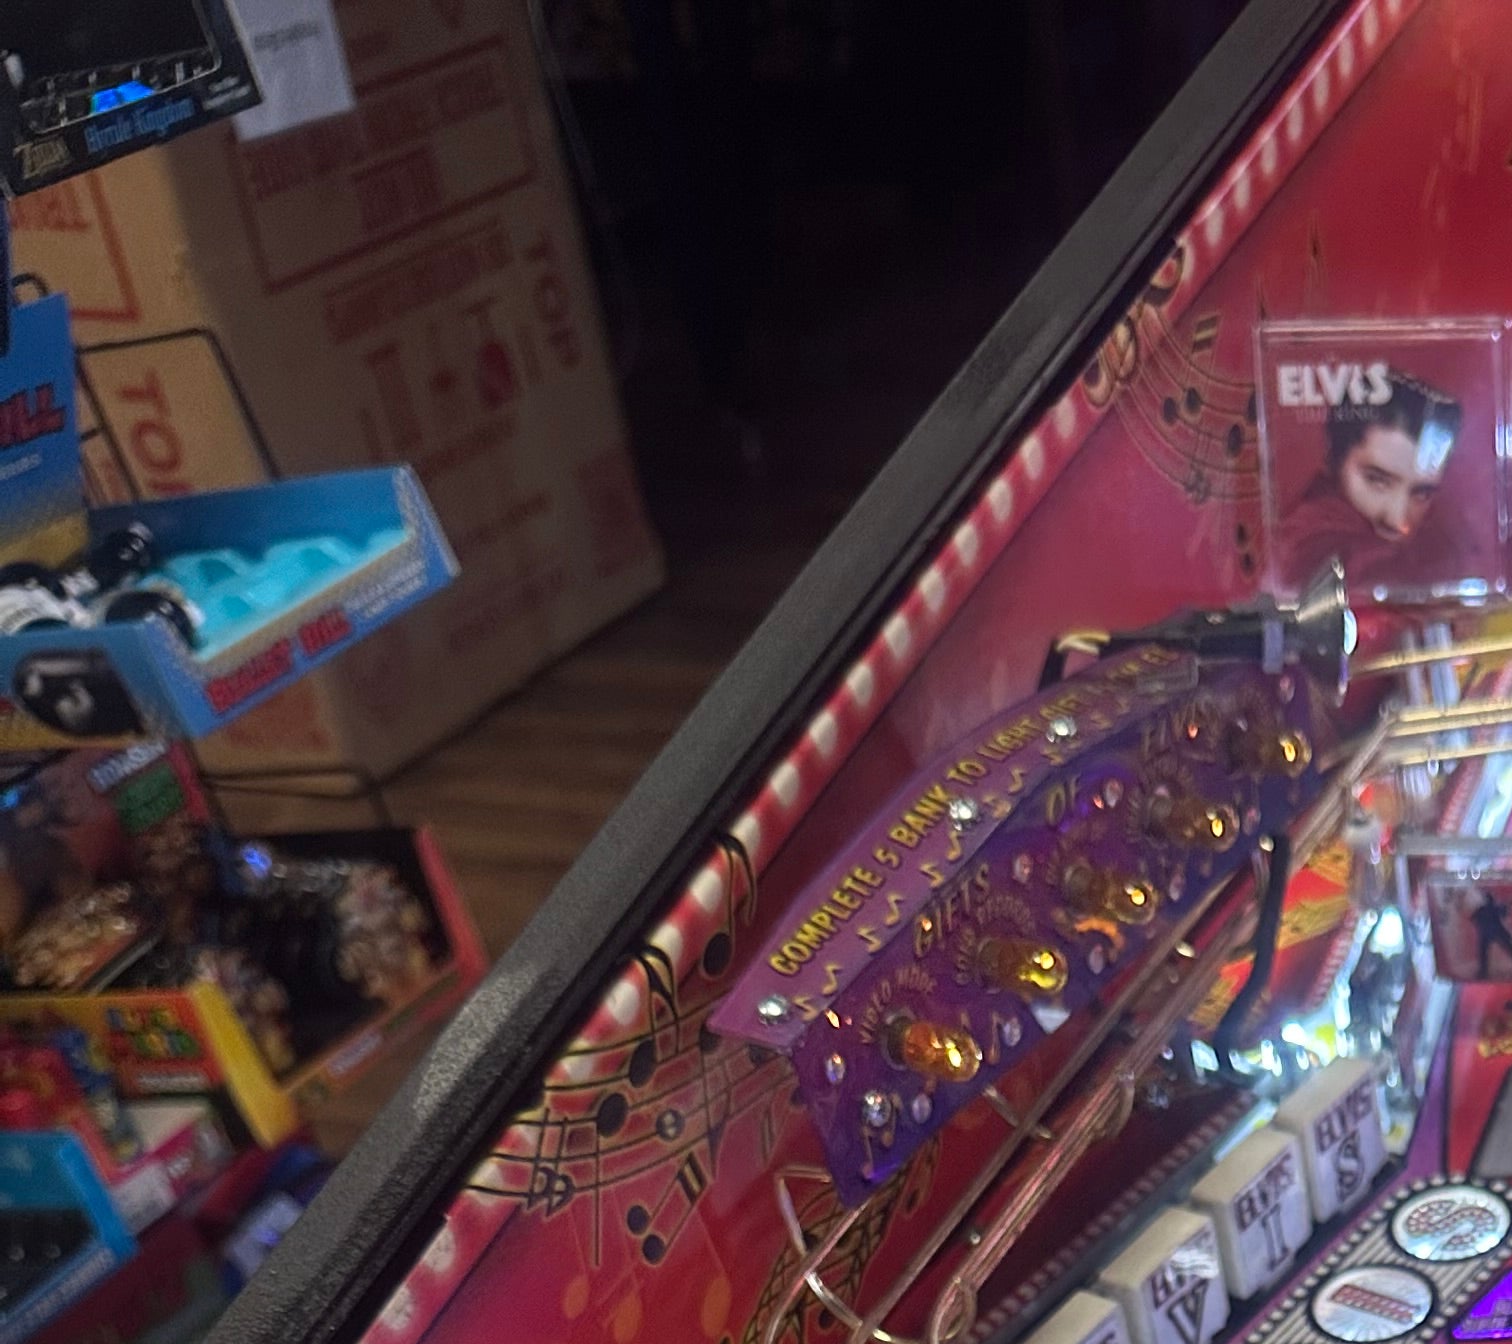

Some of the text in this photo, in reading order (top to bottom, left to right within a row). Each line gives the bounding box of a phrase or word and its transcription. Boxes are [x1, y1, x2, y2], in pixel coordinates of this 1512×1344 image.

[1276, 363, 1393, 407] ELVIS
[769, 865, 884, 978] COMPLETE
[873, 848, 902, 871] 5
[890, 784, 955, 854] BANK
[947, 757, 988, 789] TO
